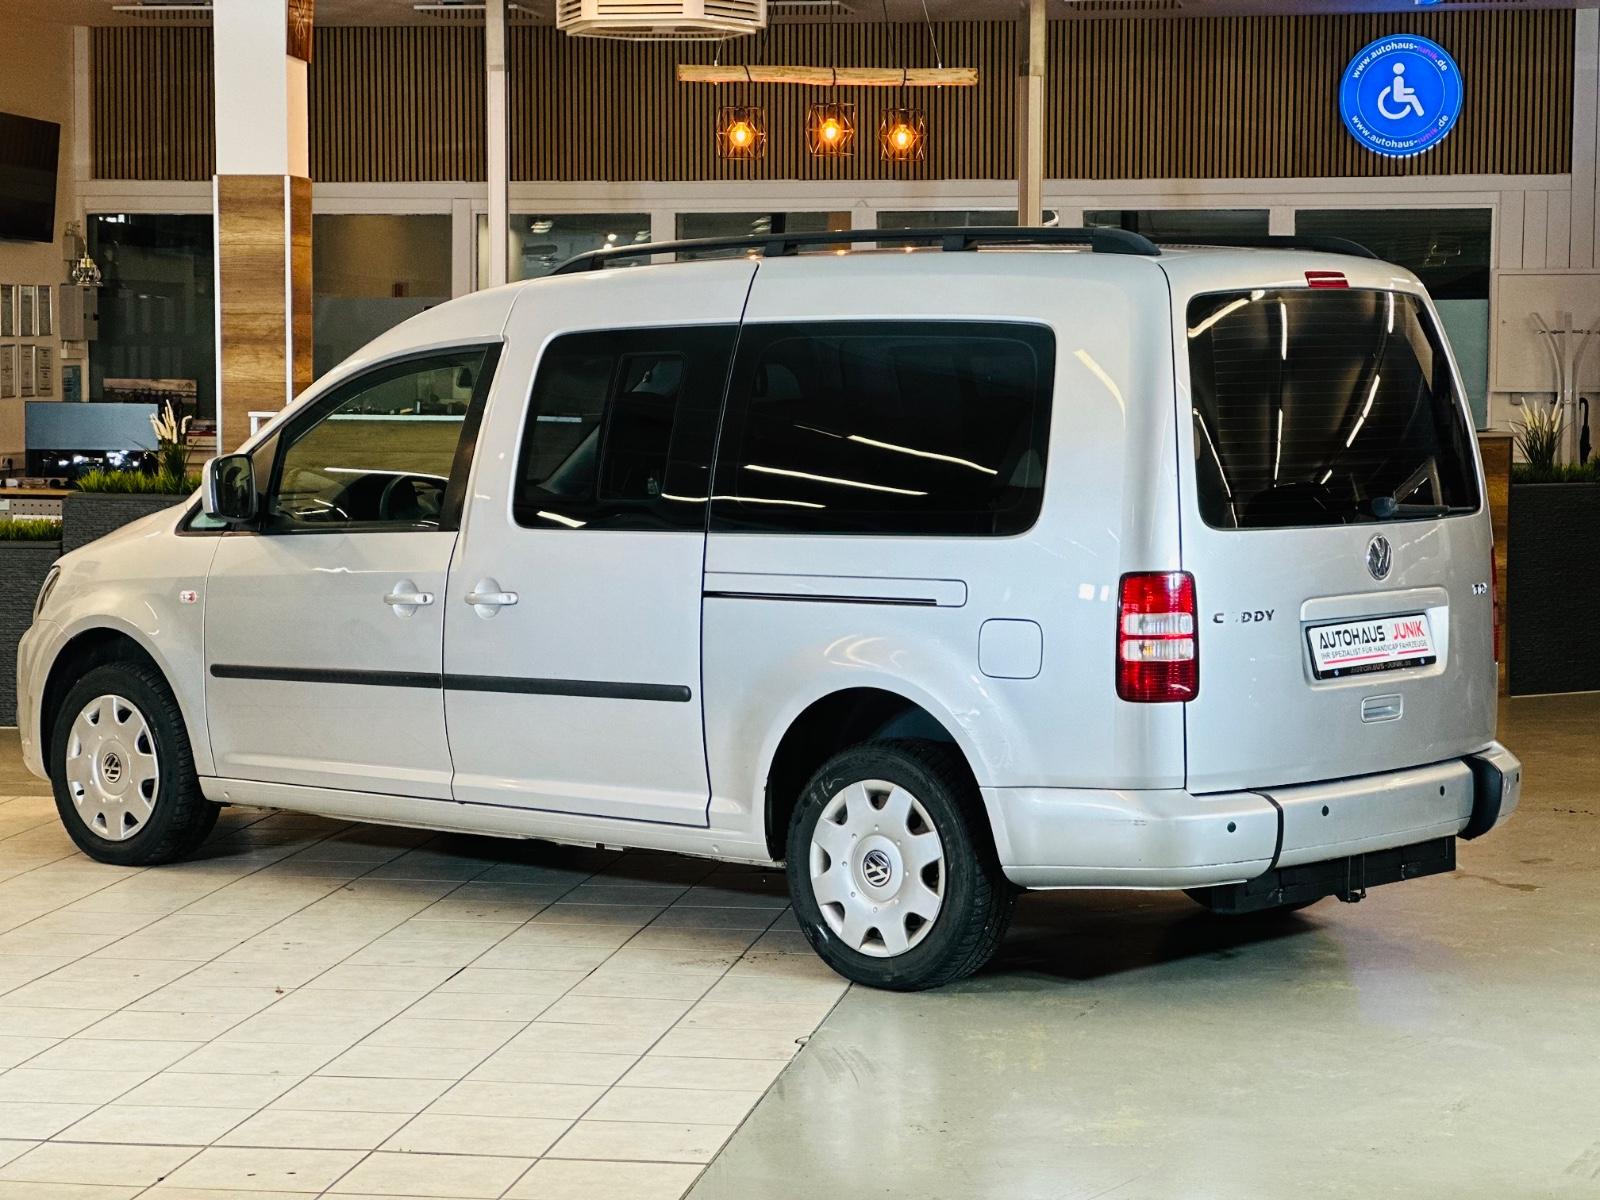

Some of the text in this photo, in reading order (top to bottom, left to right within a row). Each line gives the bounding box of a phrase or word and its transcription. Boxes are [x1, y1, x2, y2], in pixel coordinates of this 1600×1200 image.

[1353, 42, 1448, 78] www.autohaus-junik.de
[1351, 114, 1448, 148] www.autohaus-junik.de
[1213, 608, 1275, 624] CDDY
[1319, 621, 1425, 649] AUTOHAUS JUNIK
[1320, 652, 1331, 660] IHR
[1332, 648, 1361, 659] SPEZIALIST
[1373, 643, 1398, 652] HANDICAP
